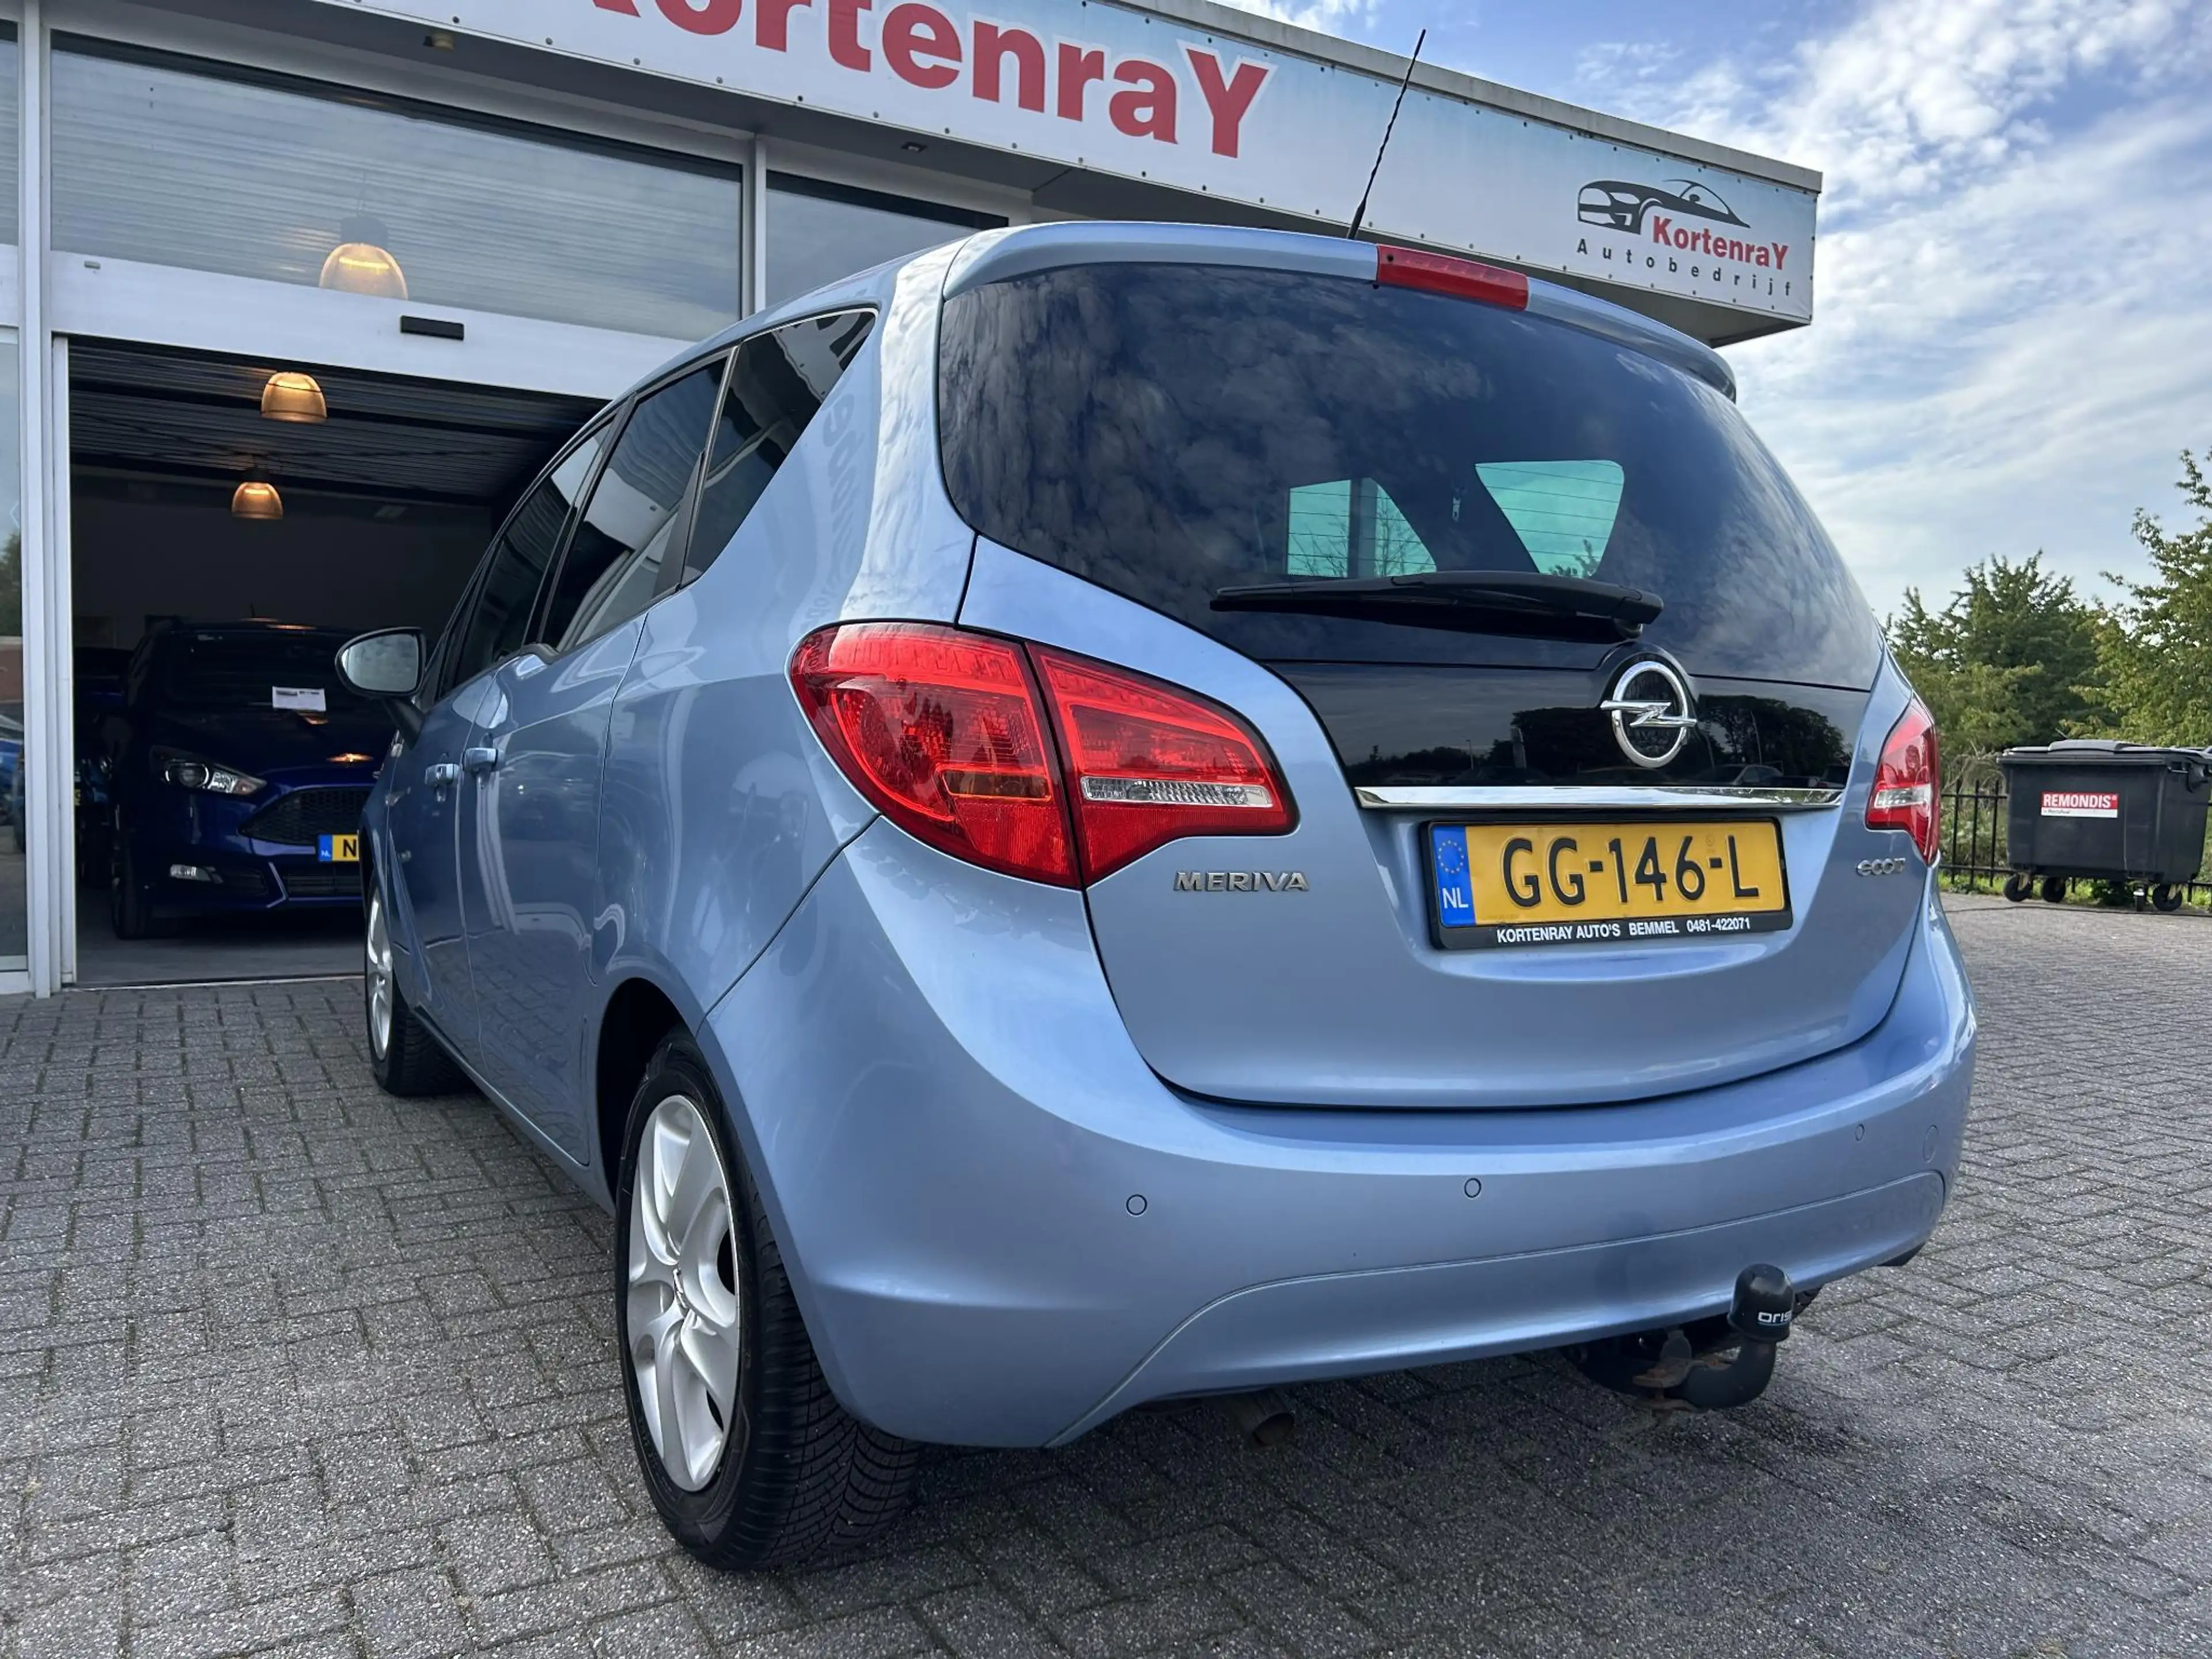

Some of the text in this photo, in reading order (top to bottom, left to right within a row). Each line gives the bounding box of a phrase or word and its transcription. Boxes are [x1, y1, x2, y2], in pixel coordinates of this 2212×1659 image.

[593, 0, 1269, 158] rtenraY
[1652, 215, 1789, 270] KortenraY
[1577, 238, 1790, 296] Autobedrijf
[2043, 794, 2111, 808] REMONDIS
[1174, 870, 1309, 892] MERIVA
[1501, 835, 1760, 908] GG-146-L
[1442, 887, 1469, 908] NL
[1497, 916, 1751, 943] KORTENRAY AUTO'S BEMMEL 0481-422071
